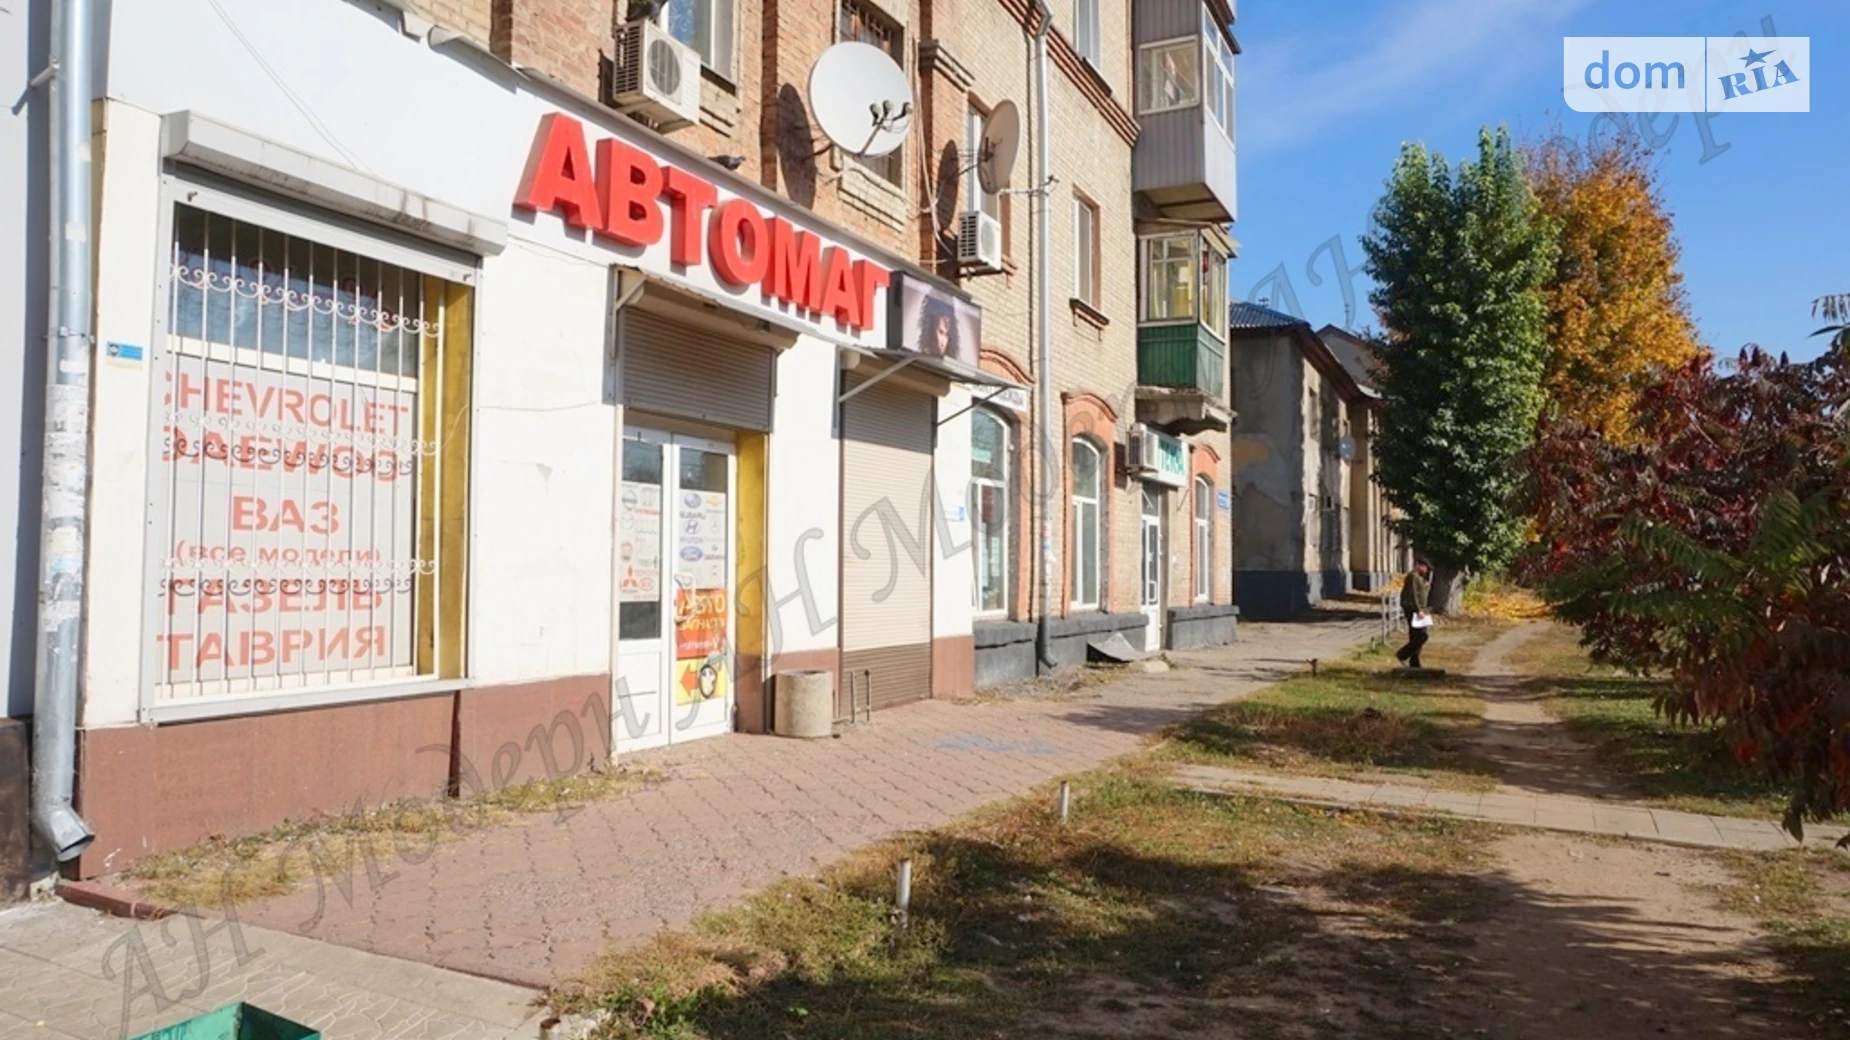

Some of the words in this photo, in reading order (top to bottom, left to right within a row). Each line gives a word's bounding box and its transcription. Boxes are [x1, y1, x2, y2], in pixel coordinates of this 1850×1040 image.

[513, 112, 890, 331] АВТОМАГ
[1159, 438, 1185, 476] ТЕКА
[232, 495, 341, 535] ВАЗ
[168, 577, 384, 615] ГАЗЕЛЬ
[157, 625, 386, 671] ТАВРИЯ
